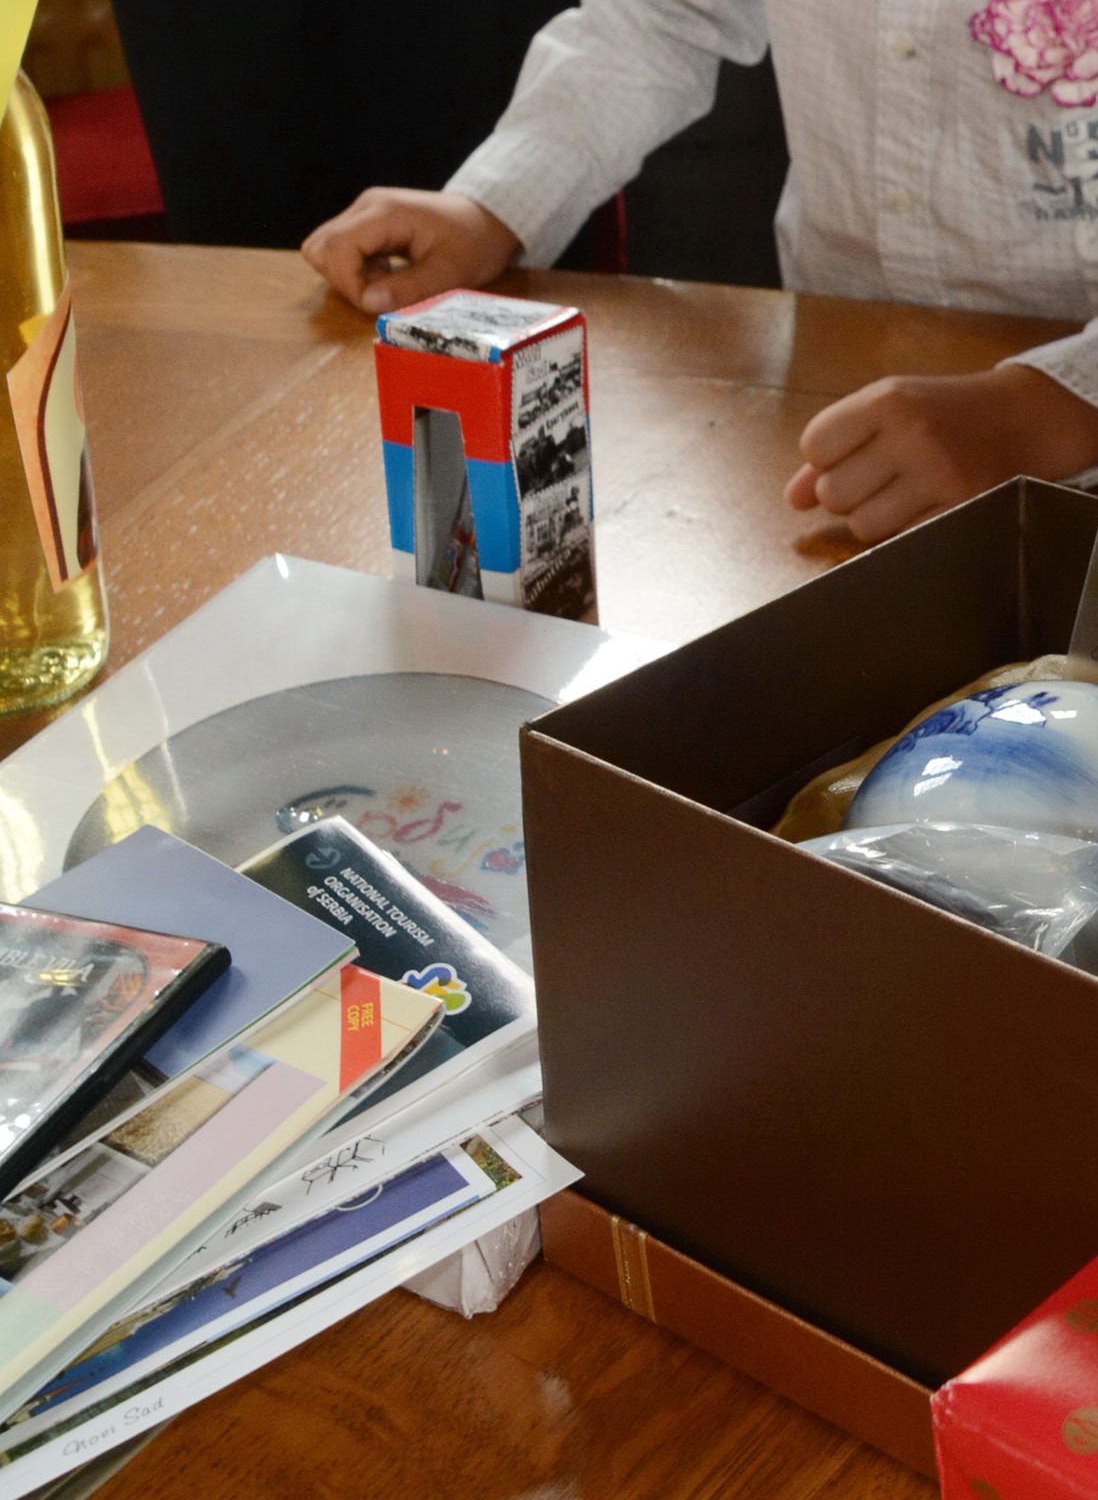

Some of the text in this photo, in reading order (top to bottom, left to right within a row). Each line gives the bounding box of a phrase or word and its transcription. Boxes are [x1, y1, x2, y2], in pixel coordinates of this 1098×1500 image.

[307, 886, 353, 925] of SERBIA
[324, 876, 397, 938] ORGANISATION
[340, 867, 435, 947] NATIONAL TOURISM
[347, 1002, 374, 1030] FREE COPY
[123, 1397, 163, 1425] Sad
